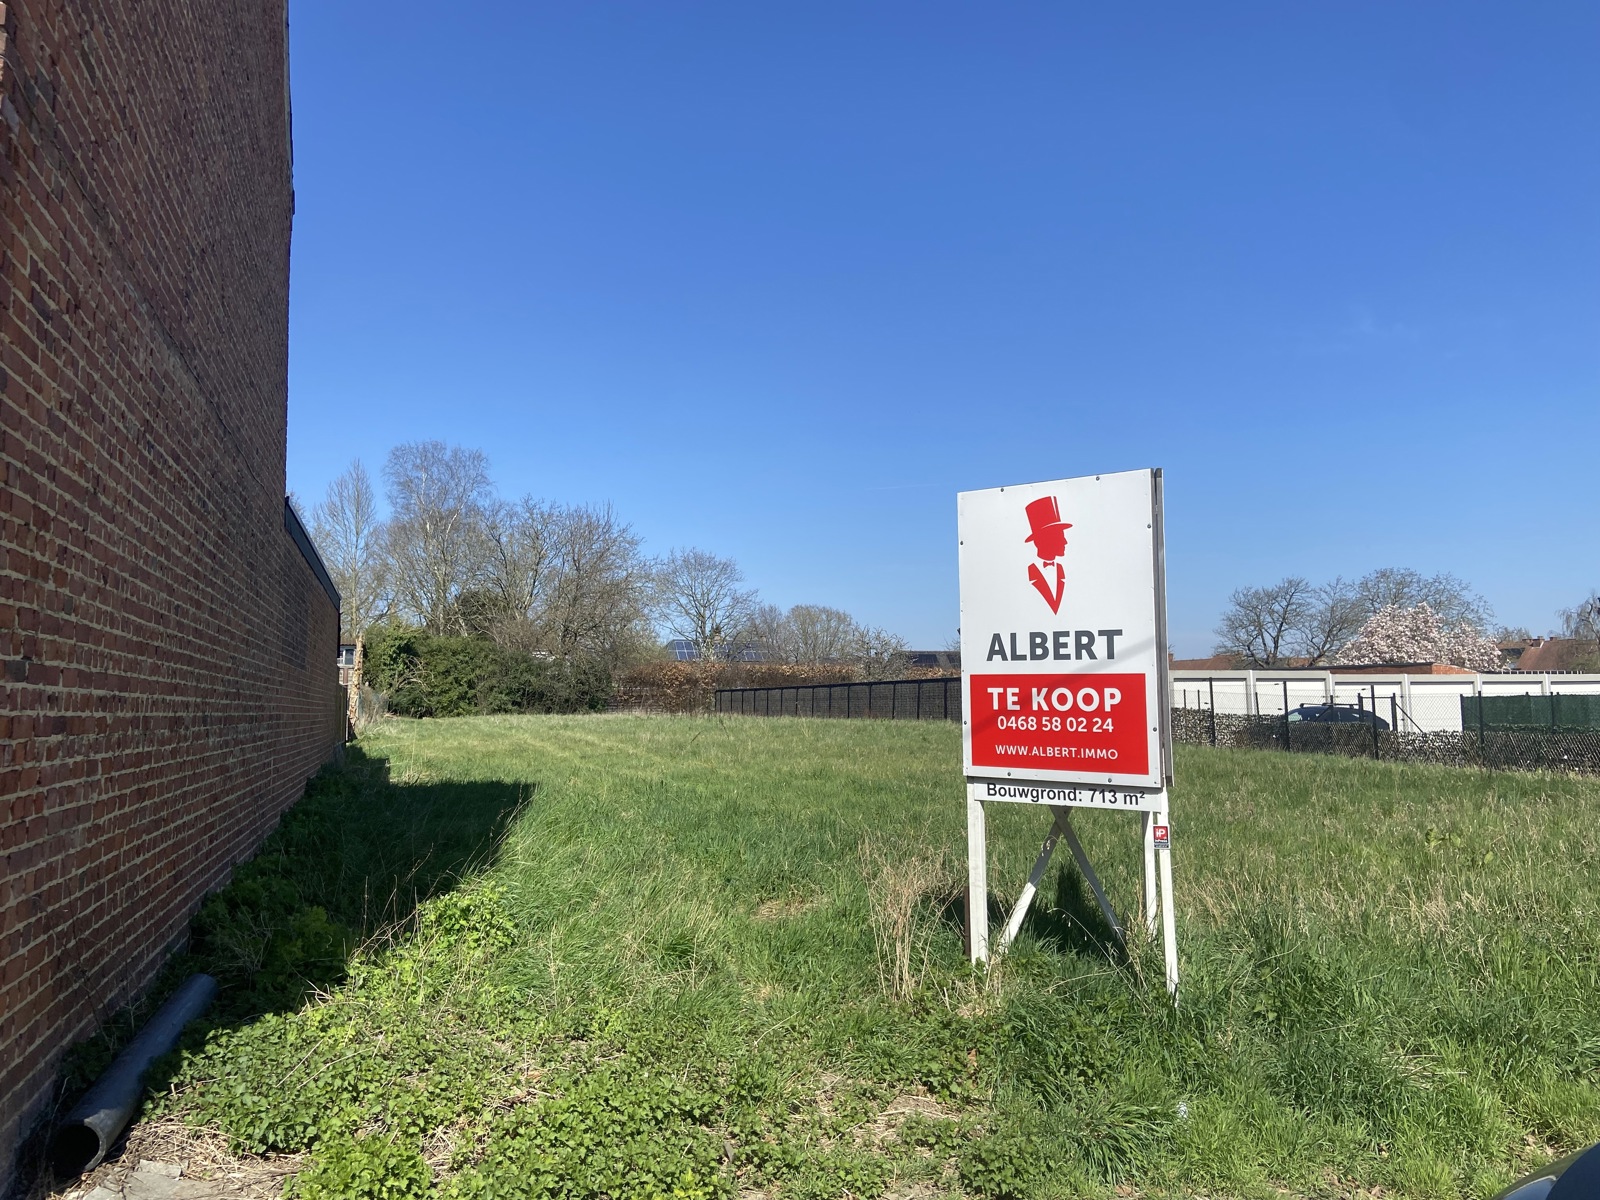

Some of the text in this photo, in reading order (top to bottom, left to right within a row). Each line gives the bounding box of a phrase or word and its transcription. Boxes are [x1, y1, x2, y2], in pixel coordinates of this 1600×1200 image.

[986, 629, 1123, 662] ALBERT
[987, 687, 1122, 712] TE KOOP
[997, 715, 1114, 733] 0468 58 02 24
[995, 744, 1119, 760] WWW.ALBERT.IMMO
[986, 782, 1083, 803] Bouwgrond:
[1088, 788, 1118, 804] 713
